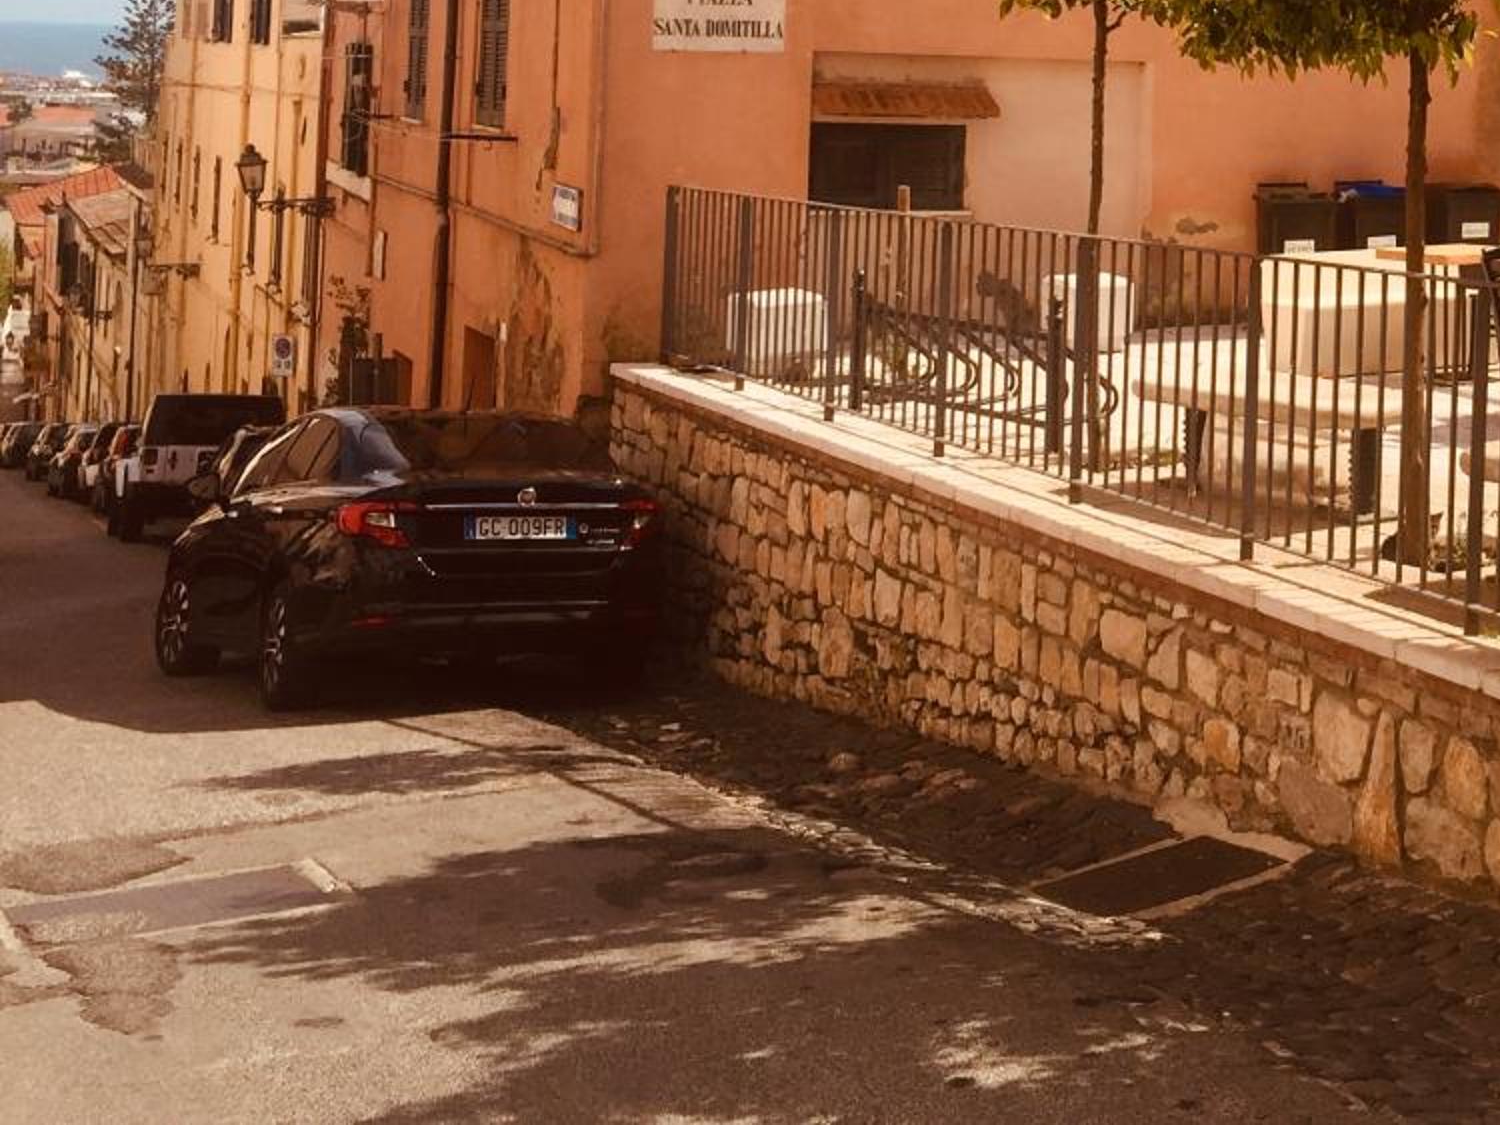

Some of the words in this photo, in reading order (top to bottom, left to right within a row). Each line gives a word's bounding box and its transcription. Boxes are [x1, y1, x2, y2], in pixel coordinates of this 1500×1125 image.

[653, 18, 700, 36] SANTA
[705, 19, 783, 38] DOMITILLA
[479, 518, 501, 536] GC
